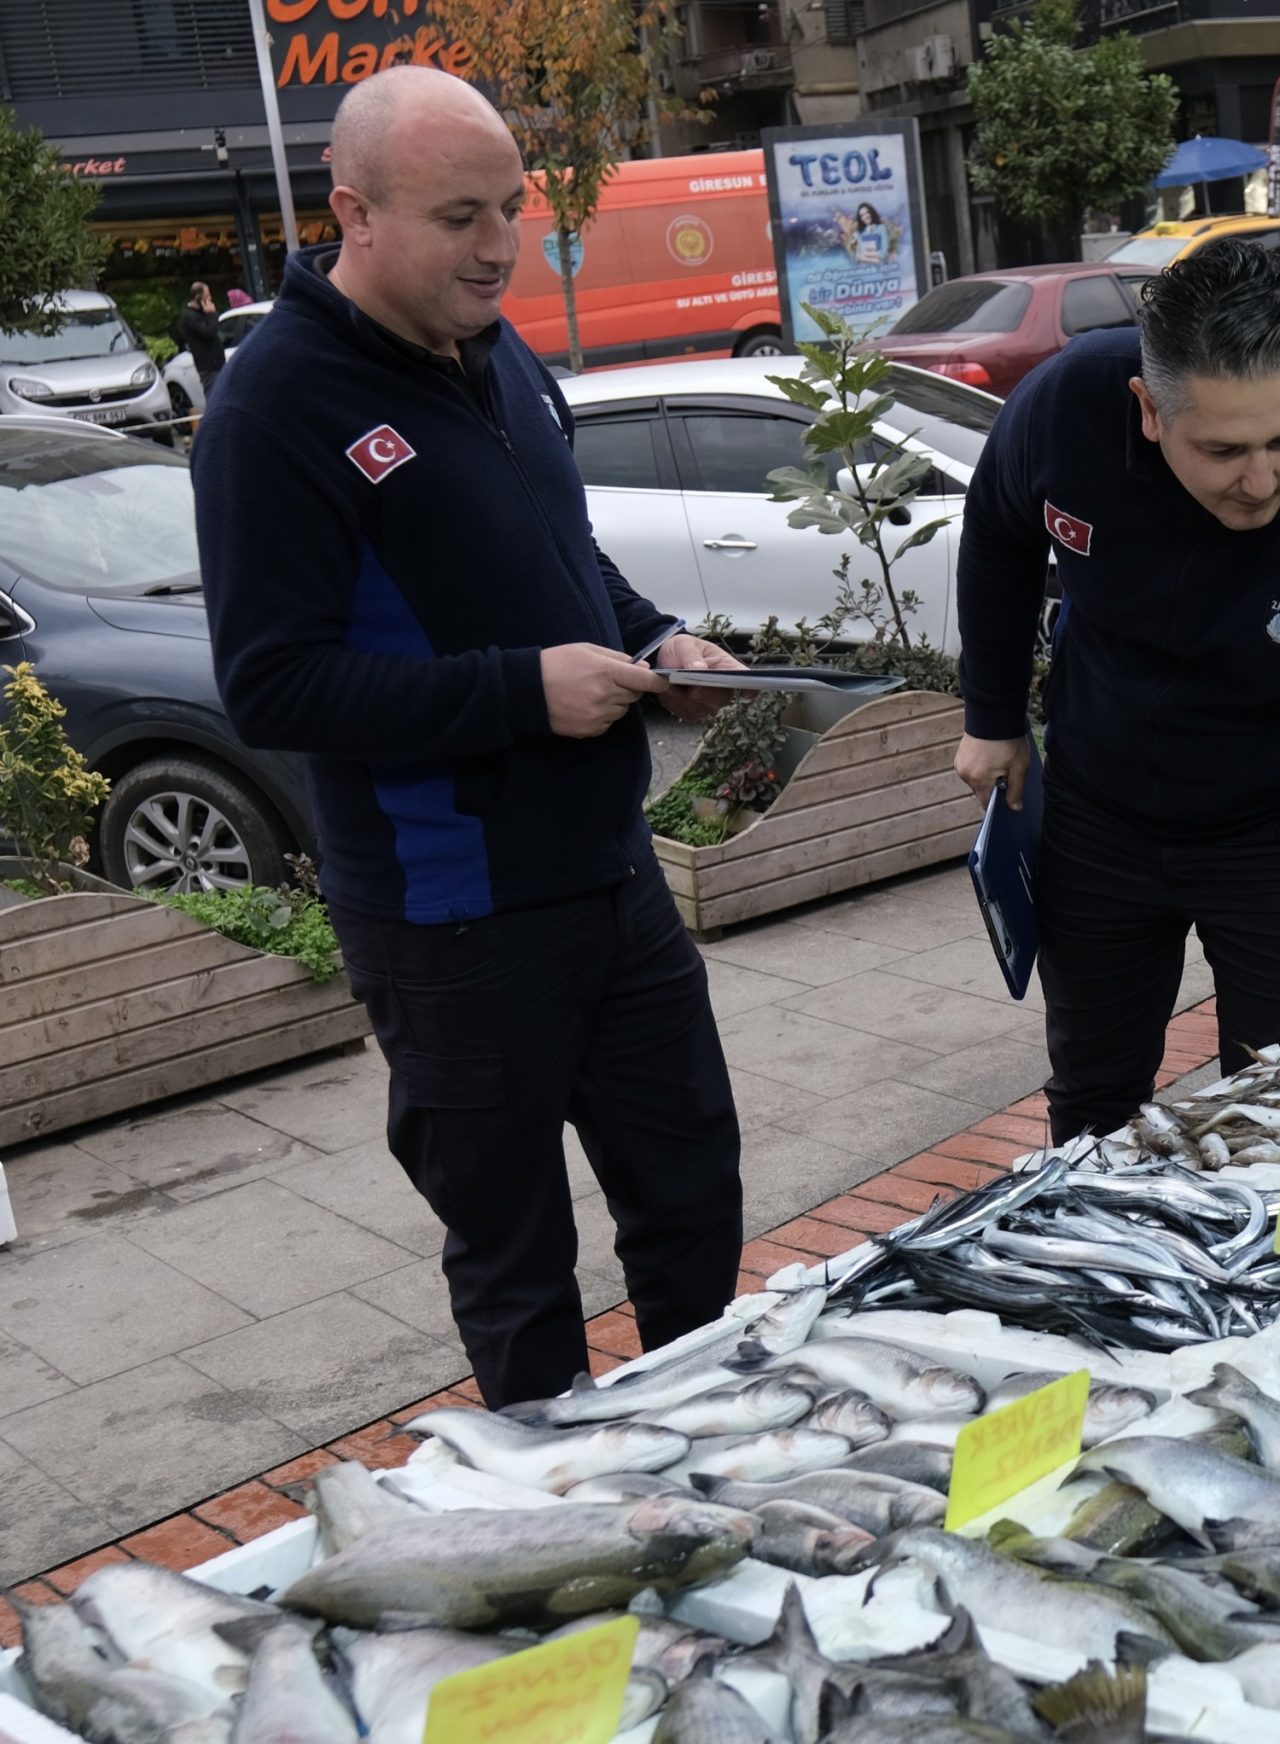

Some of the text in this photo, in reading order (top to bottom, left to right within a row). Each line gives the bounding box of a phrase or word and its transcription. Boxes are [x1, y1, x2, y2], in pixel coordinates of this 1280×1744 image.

[277, 31, 473, 88] Marke
[789, 148, 893, 188] TEOL
[689, 175, 753, 193] GİRESUN
[692, 295, 713, 307] ALTI
[714, 293, 727, 304] VE
[809, 277, 900, 304] bir Dünya
